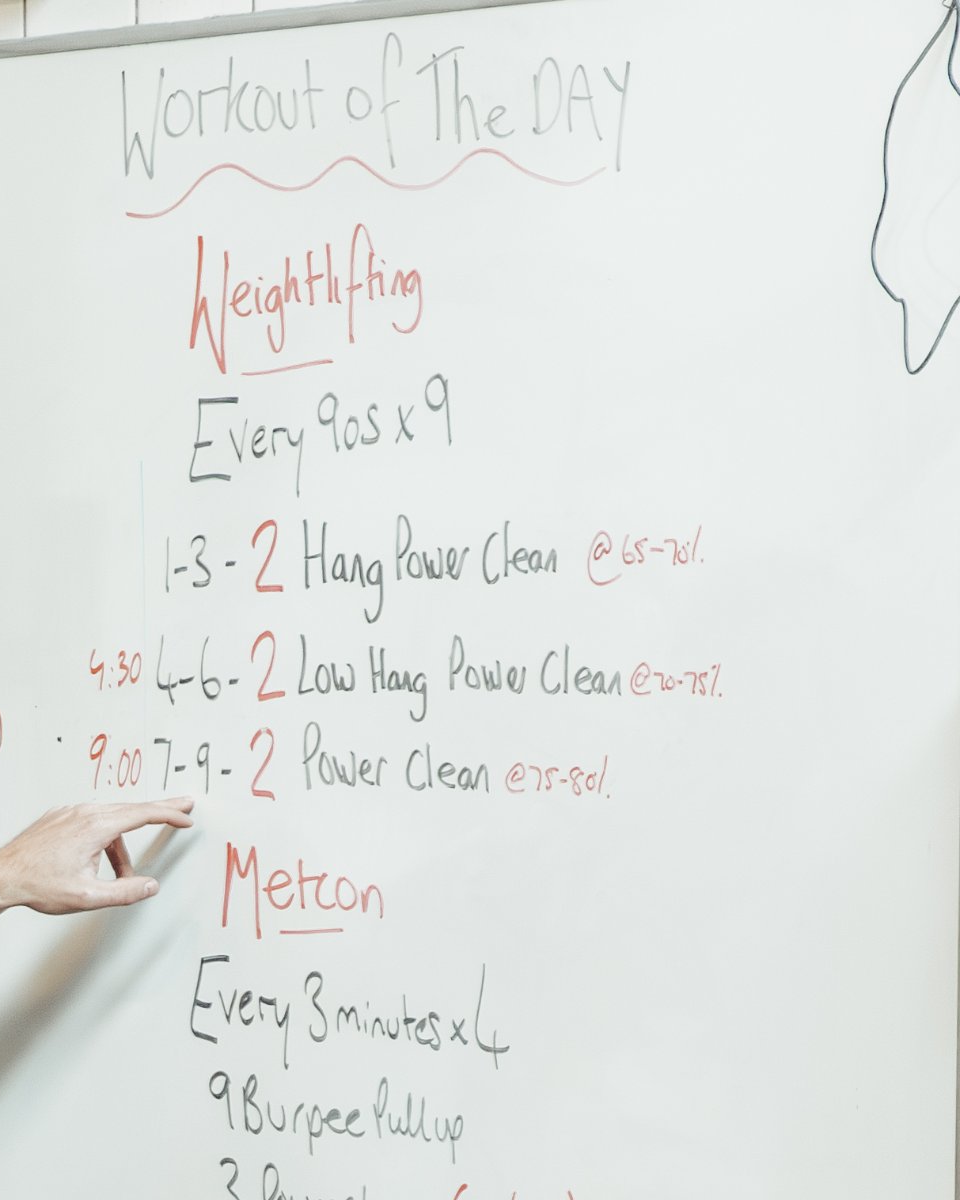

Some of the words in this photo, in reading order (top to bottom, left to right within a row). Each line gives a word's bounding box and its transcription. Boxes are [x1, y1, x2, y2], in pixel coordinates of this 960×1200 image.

[122, 56, 324, 180] Workout
[346, 32, 402, 169] of
[416, 46, 515, 144] The
[532, 57, 631, 172] DAY
[189, 222, 424, 375] Weightlifting
[189, 396, 305, 498] Every
[317, 392, 381, 453] 90s
[302, 519, 384, 624] Hang
[395, 513, 470, 582] Power
[482, 520, 558, 585] Clean
[298, 633, 356, 695] Low
[368, 645, 428, 723] Hang
[448, 634, 527, 695] Power
[540, 643, 623, 697] Clean
[302, 721, 388, 791] Power
[406, 742, 490, 794] Clean
[221, 841, 385, 940] Metcon
[189, 954, 291, 1071] Every
[304, 970, 328, 1042] 3
[336, 993, 442, 1051] minutes
[208, 1070, 235, 1131] 9
[242, 1073, 366, 1157] Burpee
